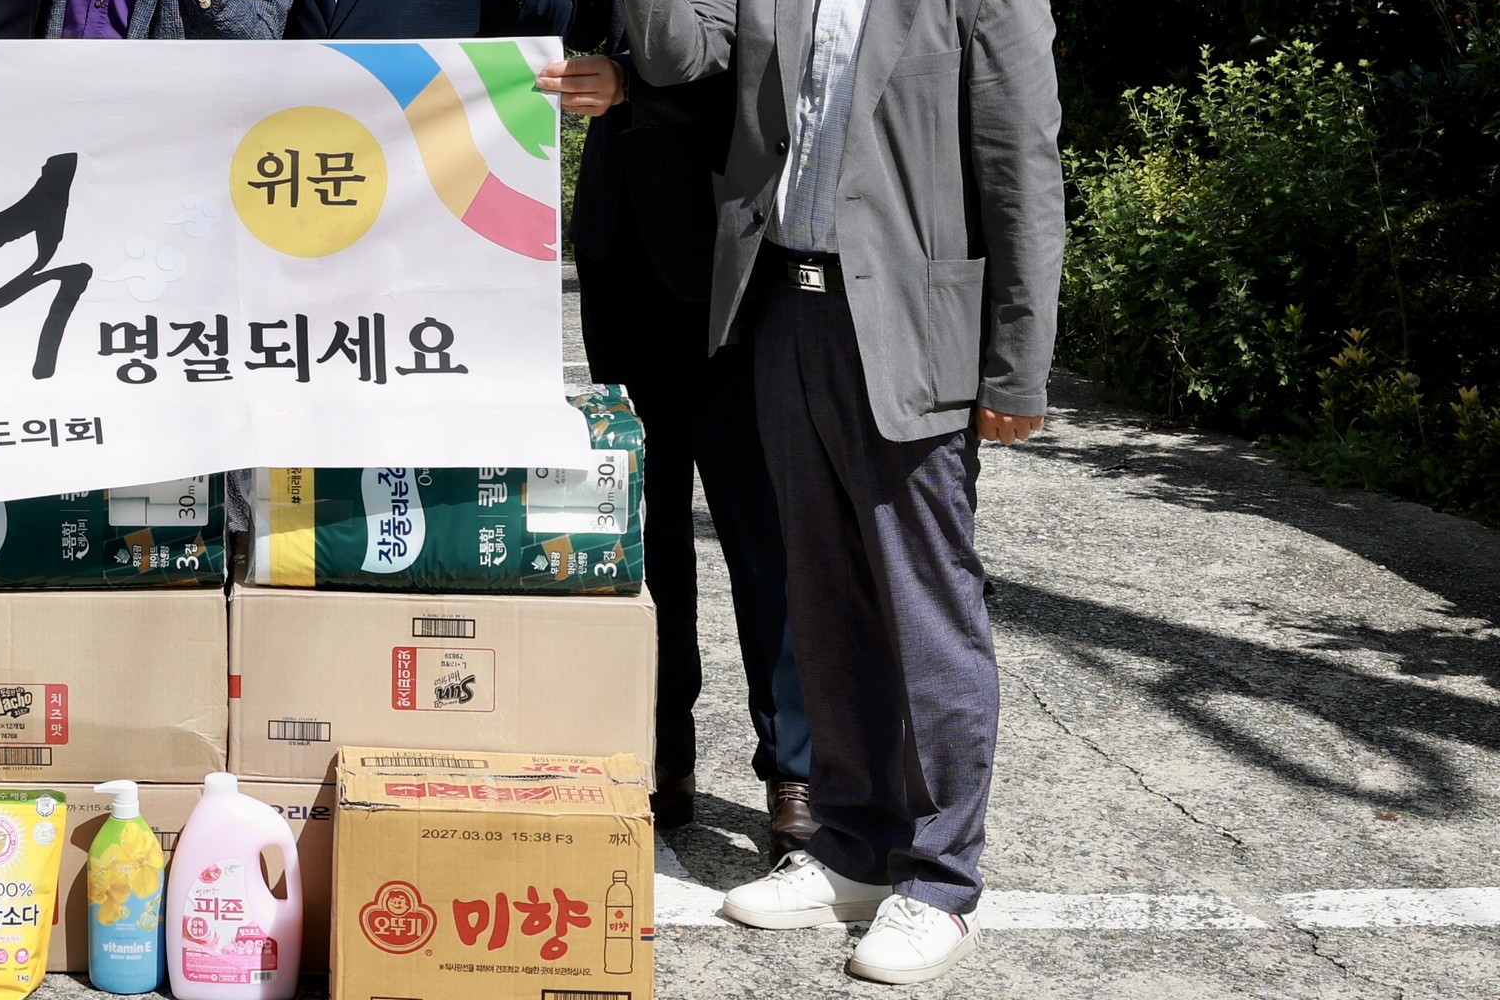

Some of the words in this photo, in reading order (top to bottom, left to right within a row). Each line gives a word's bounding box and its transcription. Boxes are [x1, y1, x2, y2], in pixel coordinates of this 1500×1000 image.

[247, 149, 367, 207] 위문
[479, 527, 495, 568] 도톰함
[594, 550, 618, 579] 3겹
[433, 674, 476, 706] Sun
[421, 829, 503, 842] 2027.03.03
[511, 830, 552, 843] 15:38
[555, 834, 574, 845] F3
[608, 832, 632, 847] 까지
[193, 897, 245, 921] 피죤
[451, 884, 593, 961] 미향
[374, 915, 423, 937] 오뚜기
[609, 921, 630, 933] 미향
